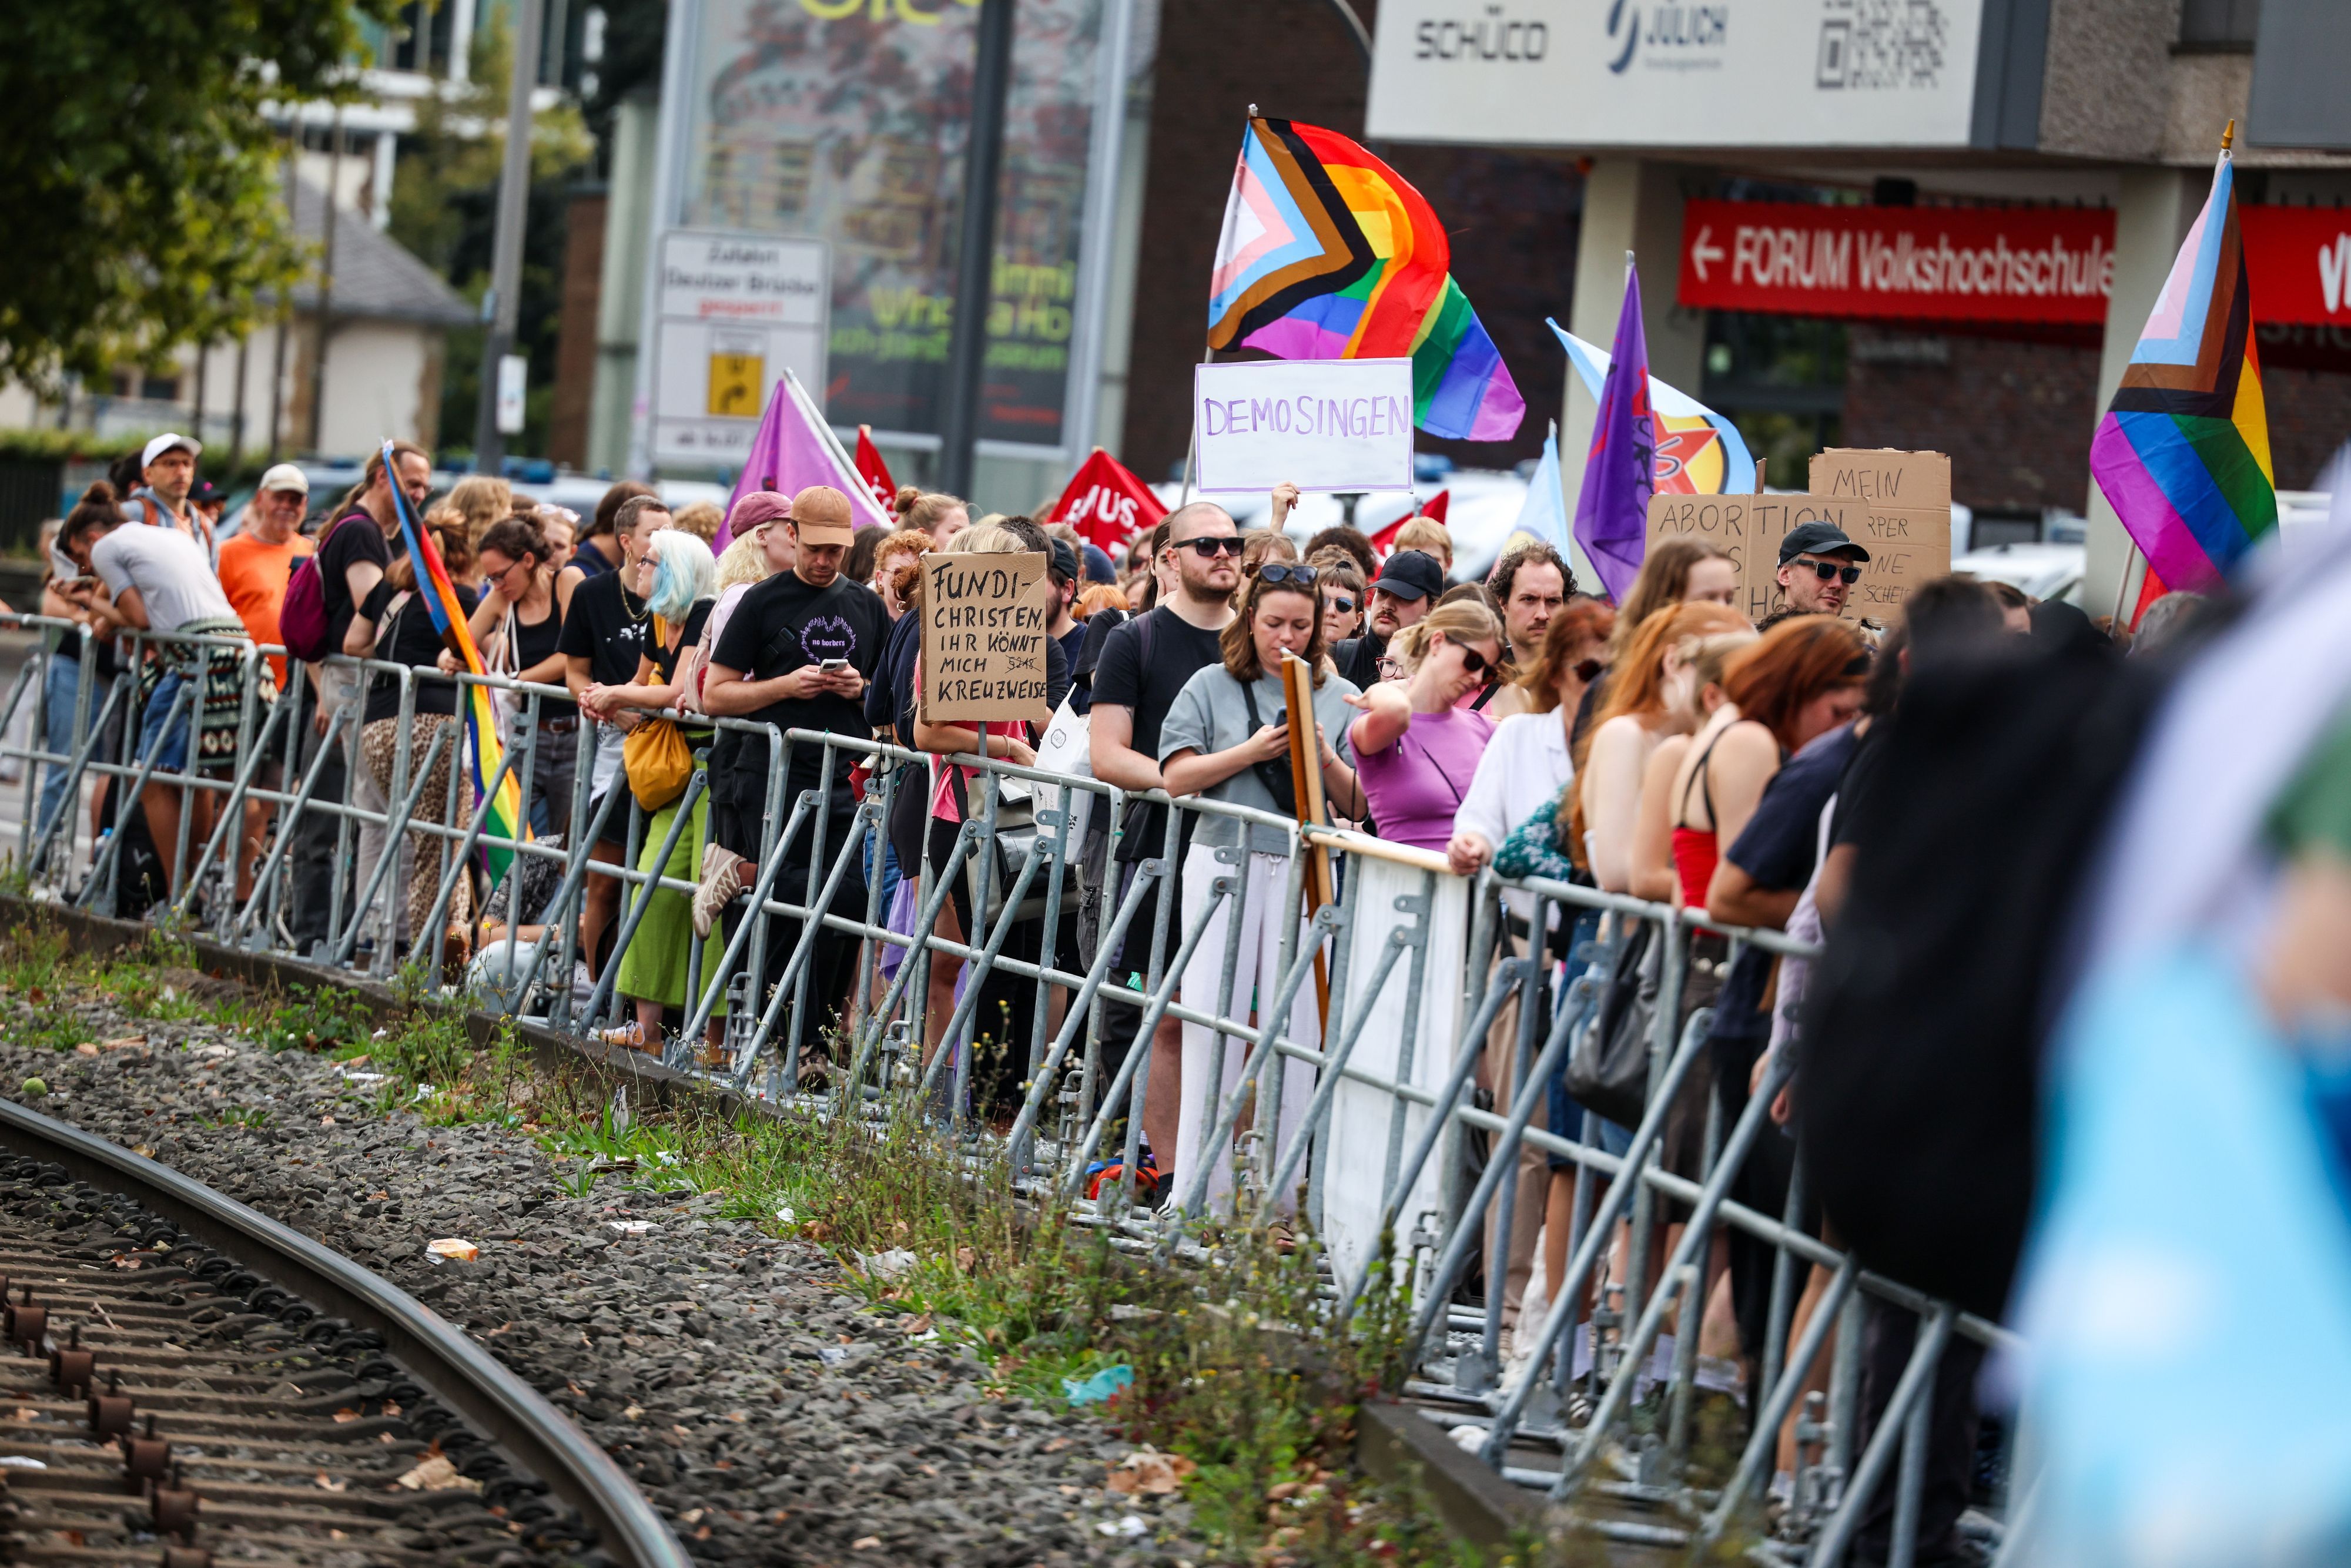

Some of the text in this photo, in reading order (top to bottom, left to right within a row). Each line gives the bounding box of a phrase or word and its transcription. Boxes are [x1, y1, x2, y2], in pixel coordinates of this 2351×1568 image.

[1414, 5, 1548, 63] SCHÜCO
[1732, 225, 2116, 297] FORUM Volkshochschule
[1204, 395, 1409, 439] DEMOSINGEN
[1832, 468, 1903, 499] MEIN
[1658, 502, 1843, 537] ABORTION
[1867, 516, 1908, 538] RPER
[1867, 552, 1912, 575] INE
[931, 561, 1032, 603] FUNDI-
[935, 605, 1043, 631] CHRISTEN,
[941, 631, 1043, 653] IHR KÖNNT
[940, 657, 987, 674] MICH
[938, 679, 1046, 702] KREUZWEISE
